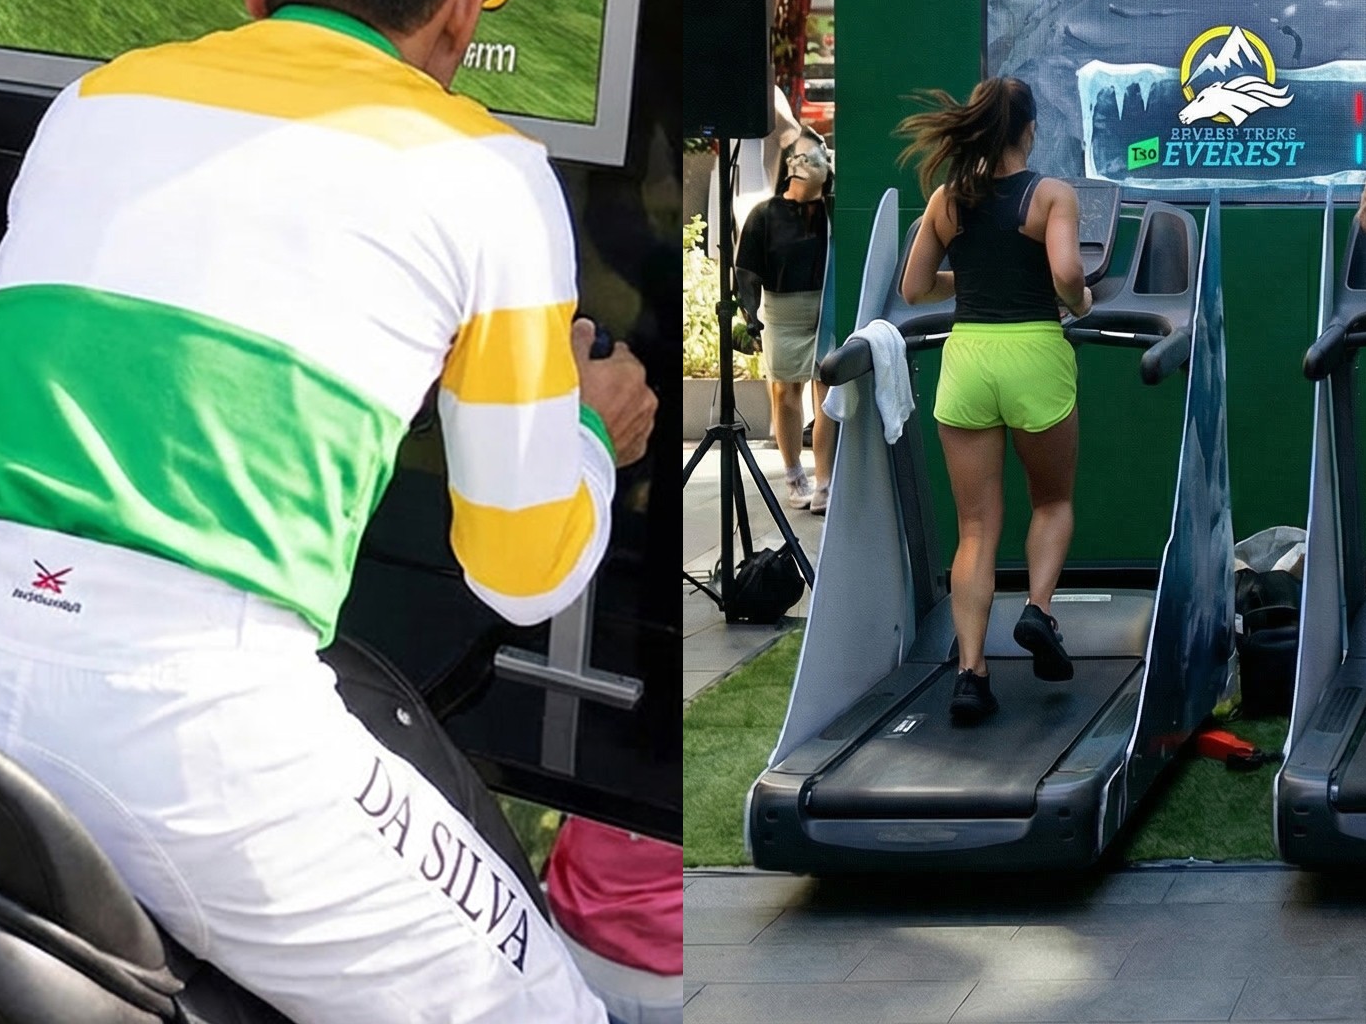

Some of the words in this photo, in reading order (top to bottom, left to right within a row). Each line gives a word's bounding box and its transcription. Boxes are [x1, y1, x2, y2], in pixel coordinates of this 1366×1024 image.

[1162, 141, 1305, 167] EVEREST
[354, 756, 413, 859] DA
[419, 820, 530, 974] SILVA
